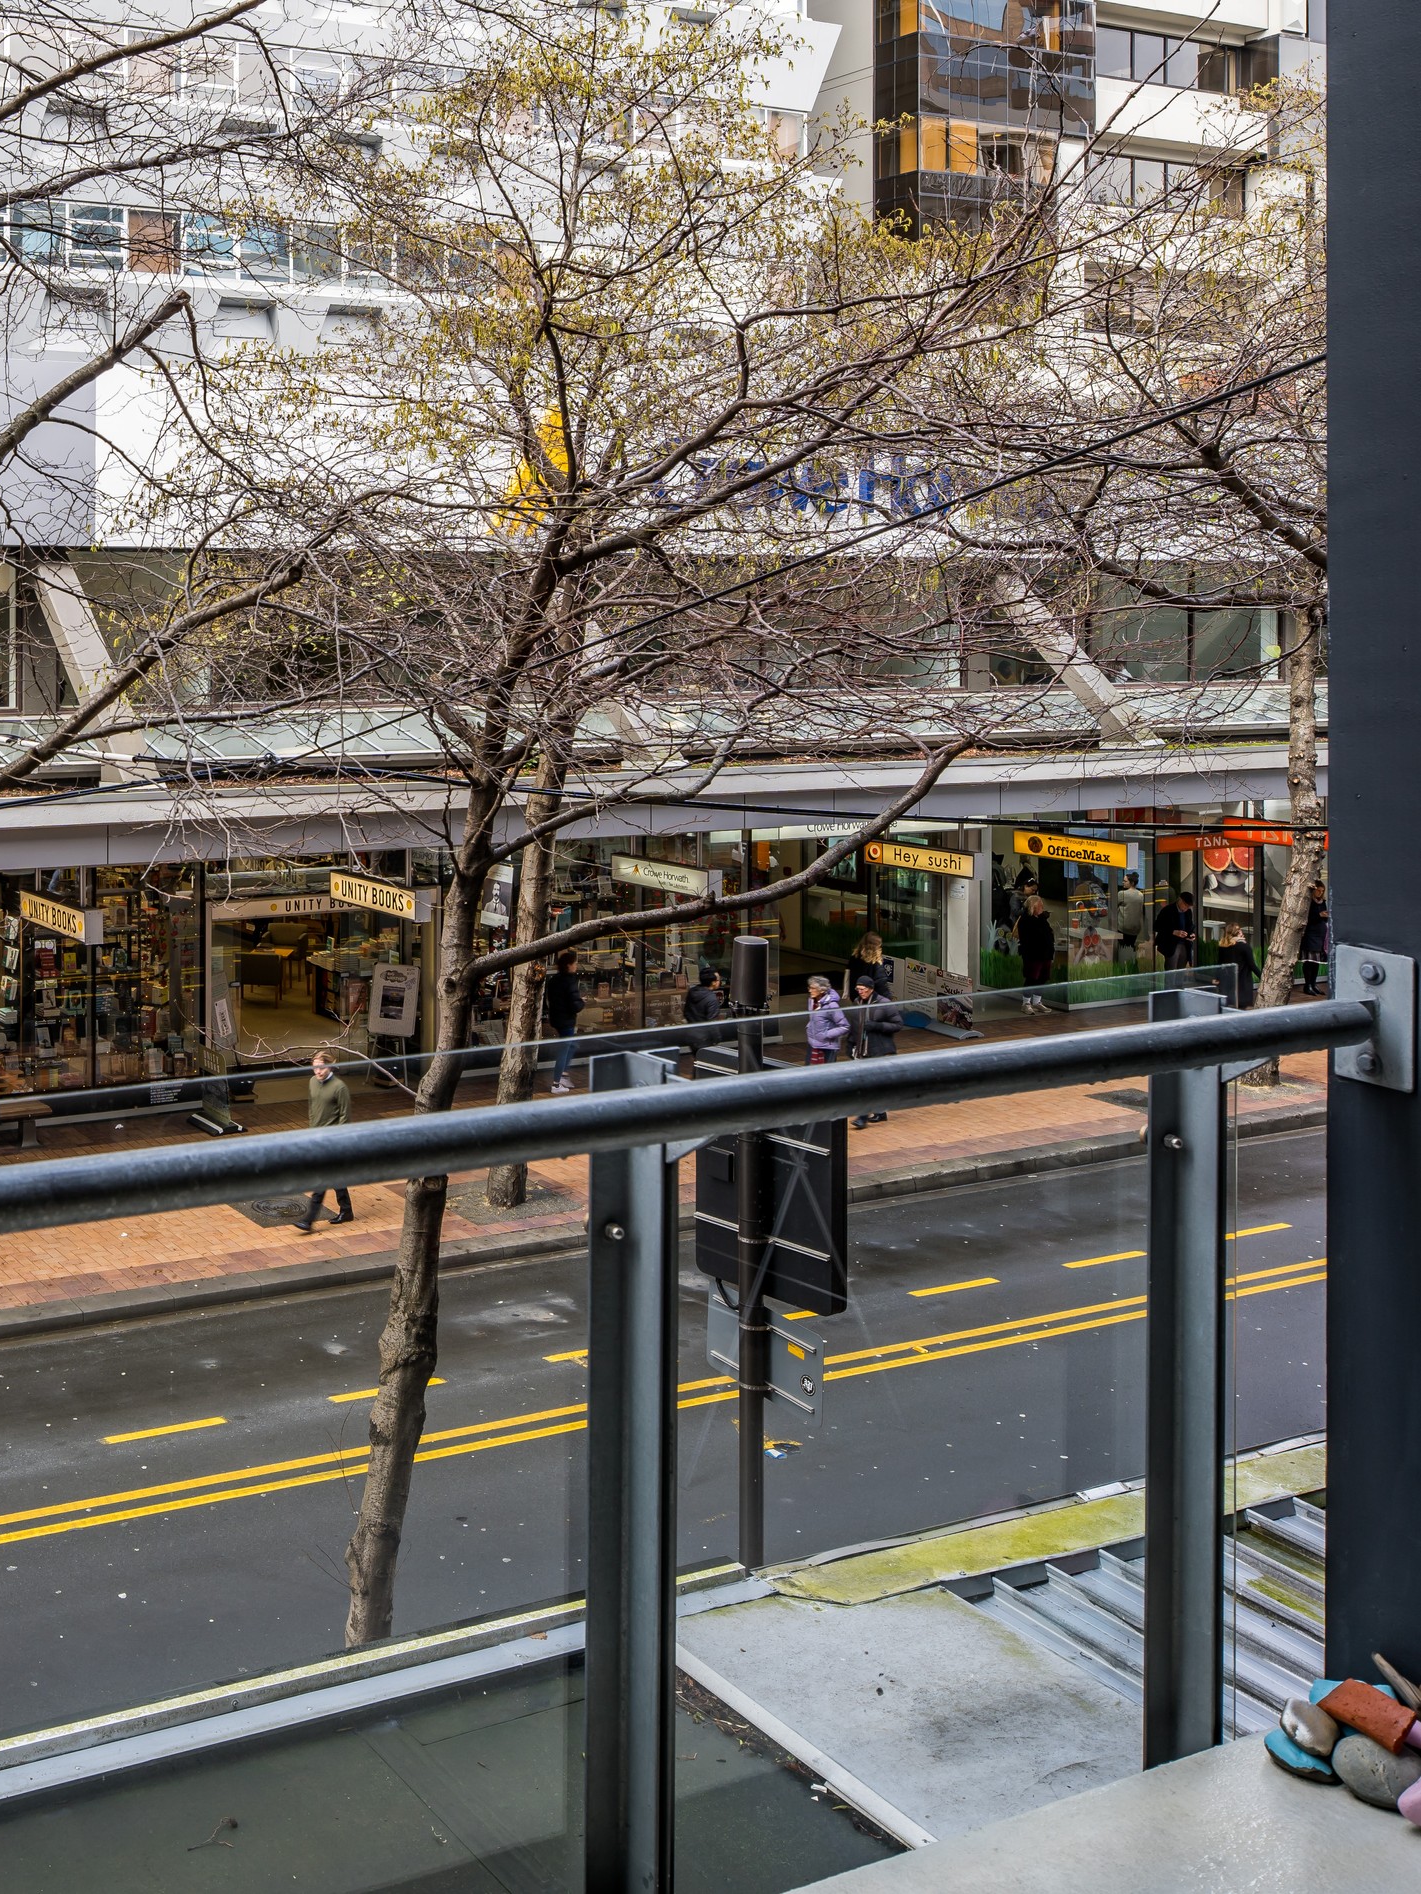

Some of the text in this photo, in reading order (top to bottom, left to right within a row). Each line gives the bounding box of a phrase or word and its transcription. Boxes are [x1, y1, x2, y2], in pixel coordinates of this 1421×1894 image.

[1064, 838, 1084, 846] Through
[1195, 836, 1229, 848] TANK
[893, 847, 962, 871] Hey sushi
[1047, 845, 1111, 863] OfficeMax
[643, 867, 662, 879] Crowe
[341, 879, 404, 912] UNITY BOOKS
[285, 898, 322, 912] UNITY
[28, 898, 77, 934] UNITY BOOKS
